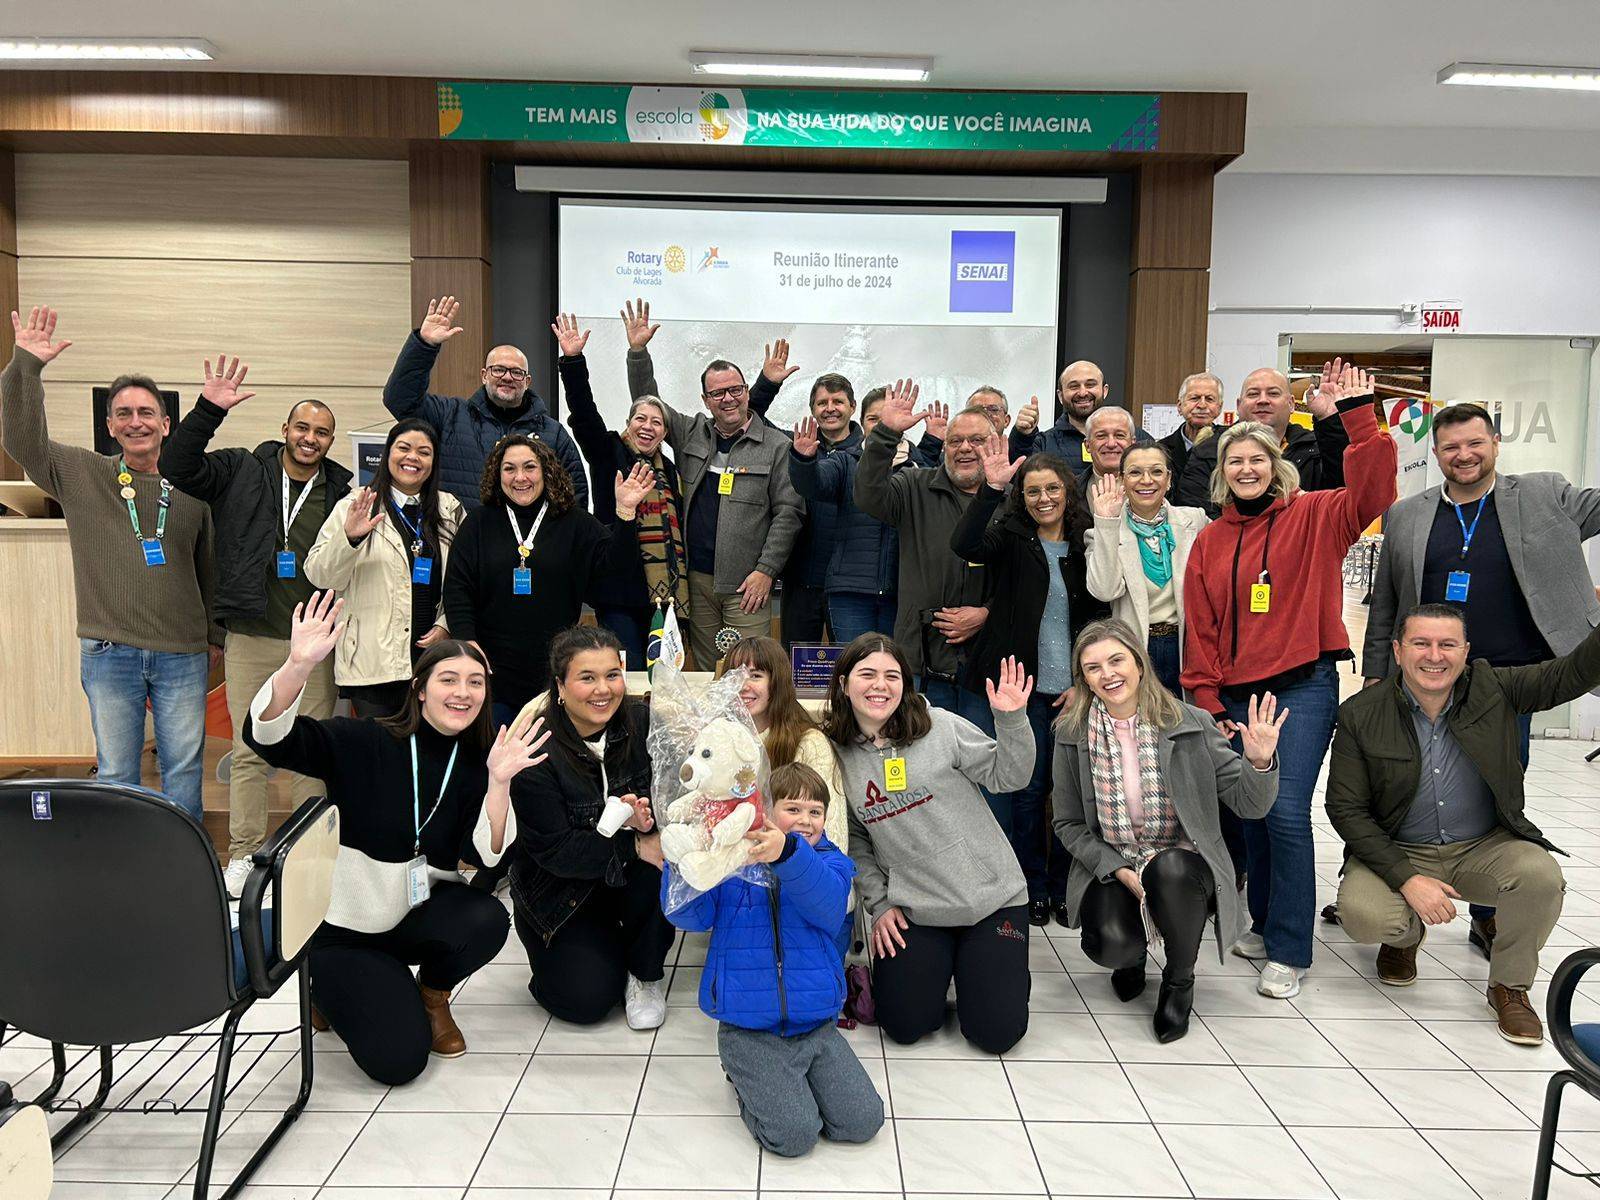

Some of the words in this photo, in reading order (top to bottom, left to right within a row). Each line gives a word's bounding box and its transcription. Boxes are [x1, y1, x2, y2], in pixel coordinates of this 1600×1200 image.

[525, 107, 565, 124] TEM
[569, 108, 618, 125] MAIS
[635, 107, 693, 125] escola
[757, 112, 783, 128] NA
[787, 113, 824, 130] SUA
[828, 113, 872, 130] VIDA
[877, 114, 905, 131] DO
[909, 114, 949, 131] QUE
[953, 111, 1004, 132] VOCÊ
[1009, 116, 1092, 133] IMAGINA
[627, 250, 662, 267] Rotary
[773, 251, 830, 267] Reunião
[834, 252, 899, 269] Itinerante
[616, 266, 632, 275] Club
[633, 266, 642, 276] de
[643, 267, 662, 278] Lages
[960, 265, 1005, 279] SENAI
[632, 276, 662, 286] Alvorada
[779, 273, 793, 287] 31
[796, 274, 811, 287] de
[813, 274, 844, 290] julho
[847, 274, 862, 288] de
[864, 275, 893, 288] 2024
